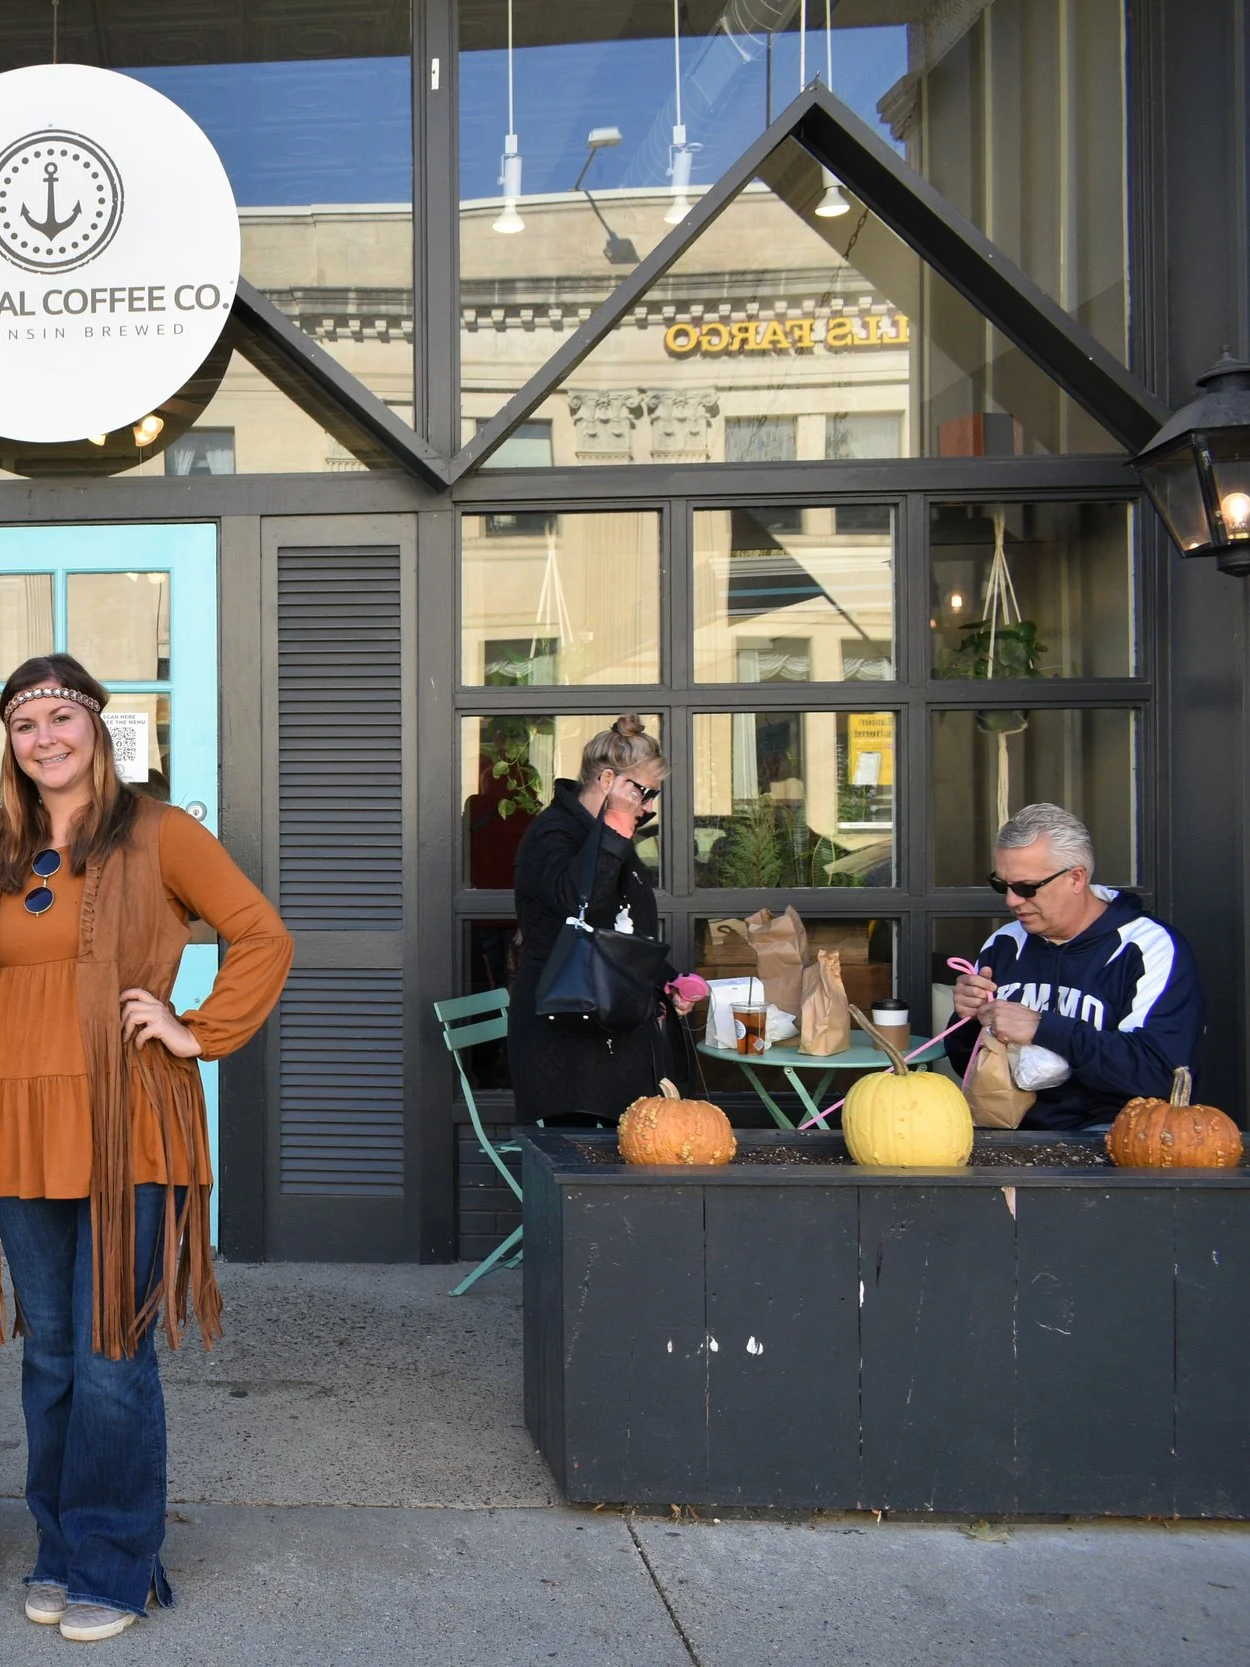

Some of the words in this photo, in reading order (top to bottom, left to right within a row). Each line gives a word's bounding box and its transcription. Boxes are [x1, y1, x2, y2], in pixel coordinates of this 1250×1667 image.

[43, 285, 166, 315] COFFEE
[173, 283, 230, 312] CO.
[84, 323, 186, 339] BREWED
